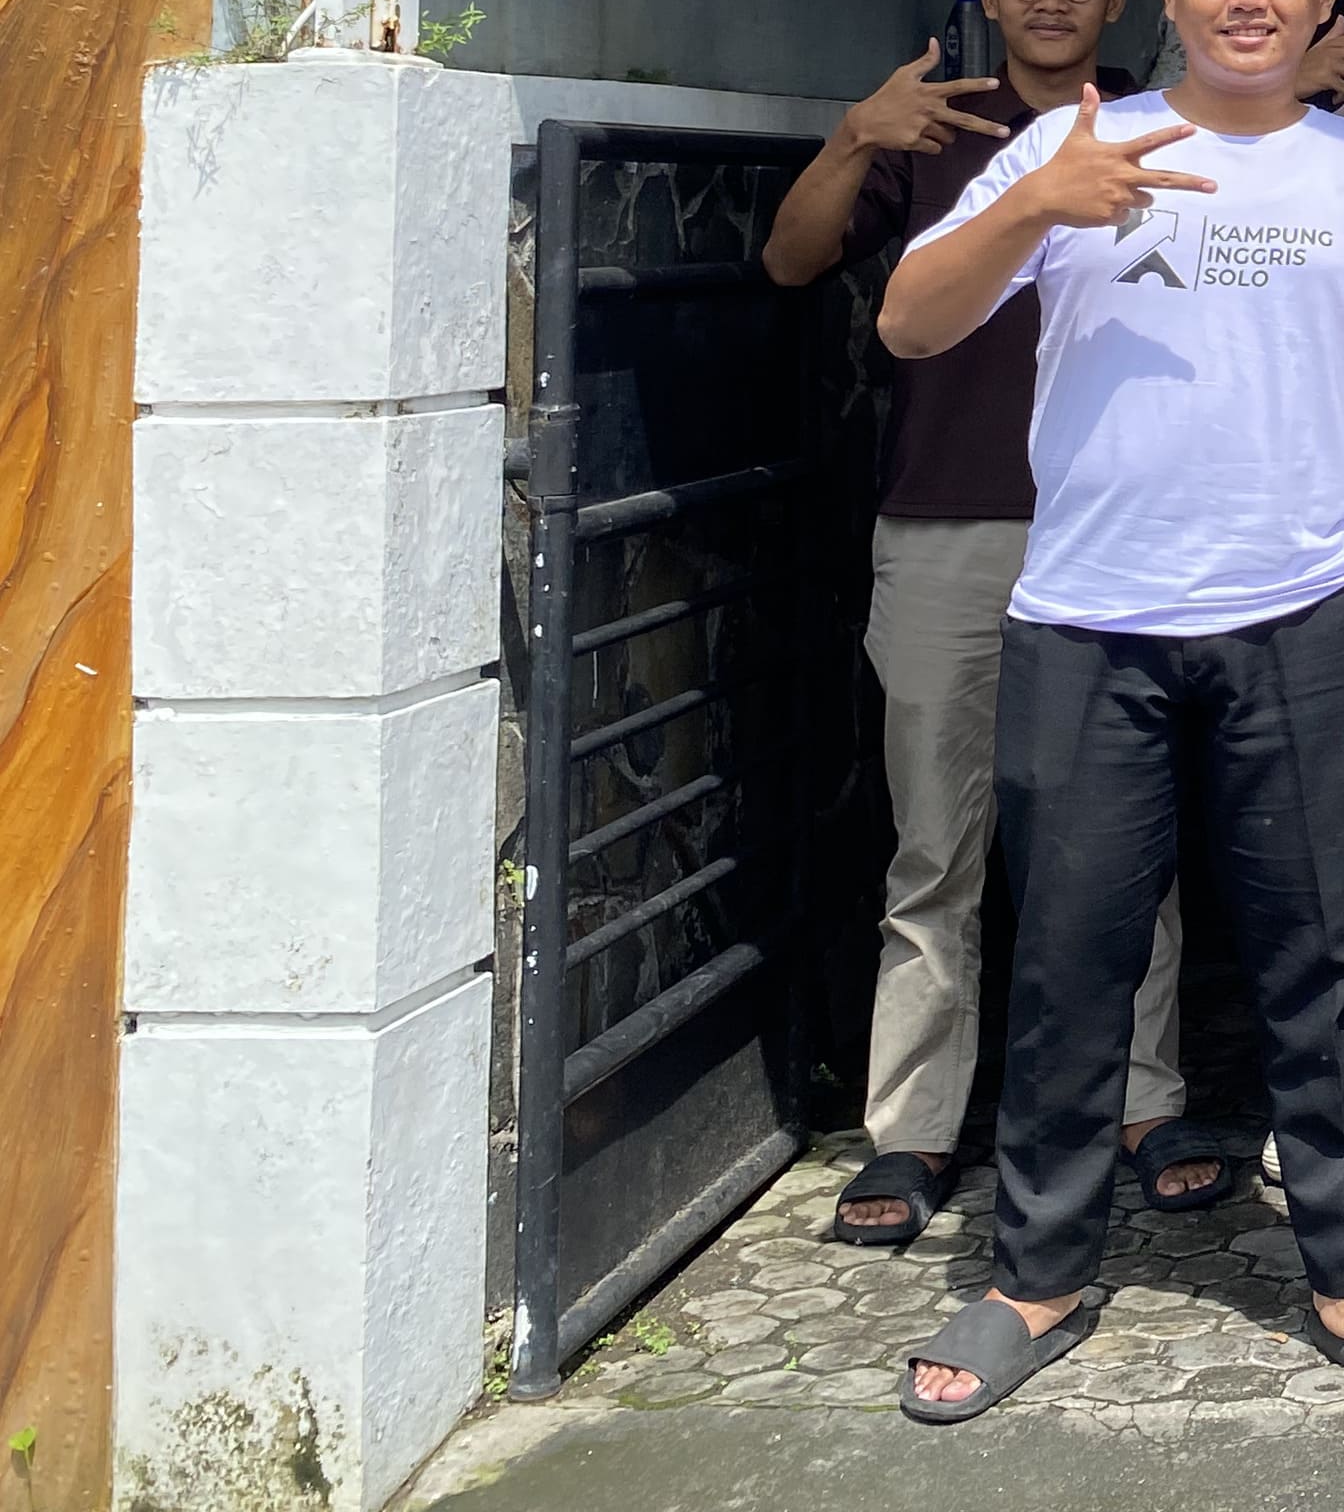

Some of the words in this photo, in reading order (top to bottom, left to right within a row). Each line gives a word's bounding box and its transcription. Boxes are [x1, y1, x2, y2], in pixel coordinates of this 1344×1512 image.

[1209, 224, 1333, 247] KAMPUNG
[1207, 246, 1306, 266] INGGRIS
[1203, 268, 1269, 287] SOLO
